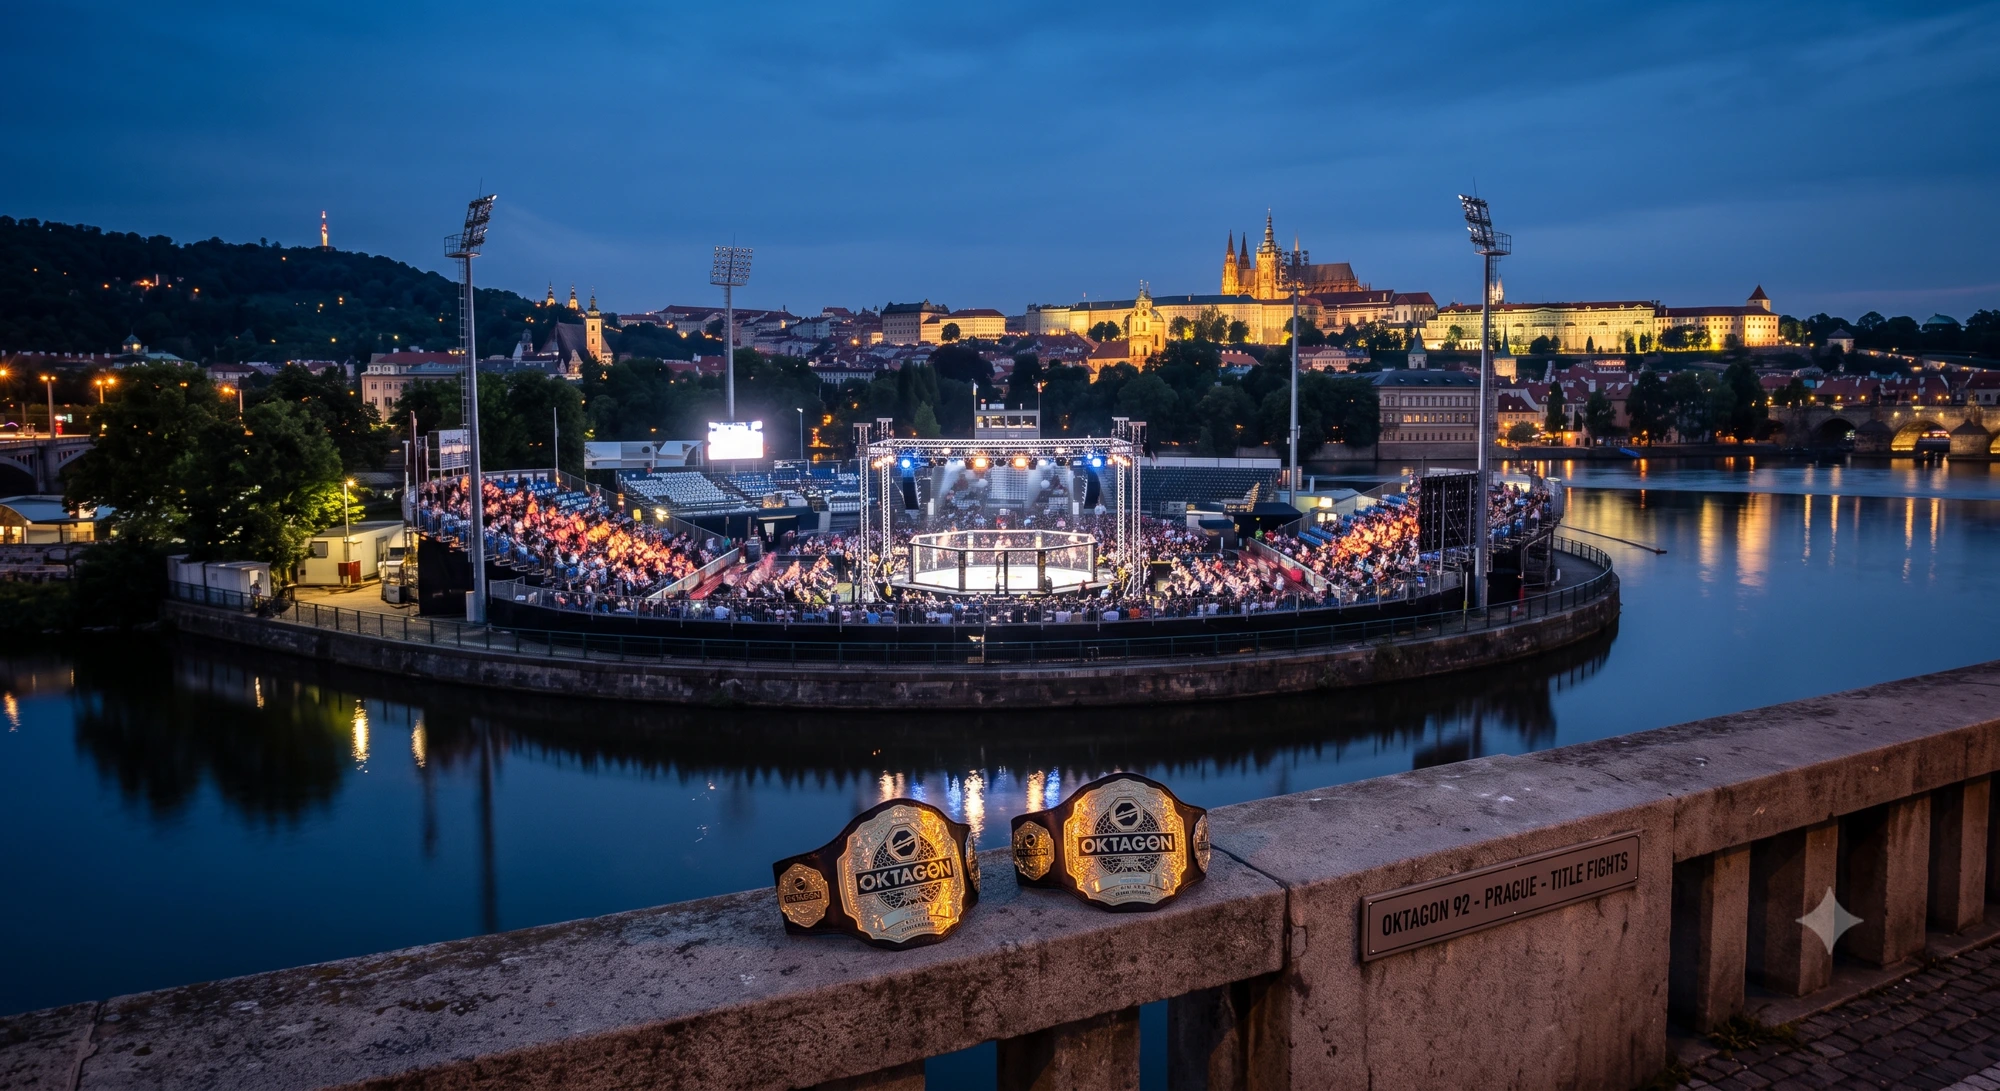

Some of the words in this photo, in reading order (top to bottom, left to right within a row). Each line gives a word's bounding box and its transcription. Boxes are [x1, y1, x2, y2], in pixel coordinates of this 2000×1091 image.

[1081, 835, 1173, 854] OKTAGON
[860, 860, 952, 890] OKTAGON
[1382, 899, 1449, 936] OKTAGON
[1453, 894, 1470, 917] 92
[1485, 875, 1537, 909] PRAGUE
[1551, 863, 1584, 890] TITLE
[1587, 851, 1628, 880] FIGHTS
